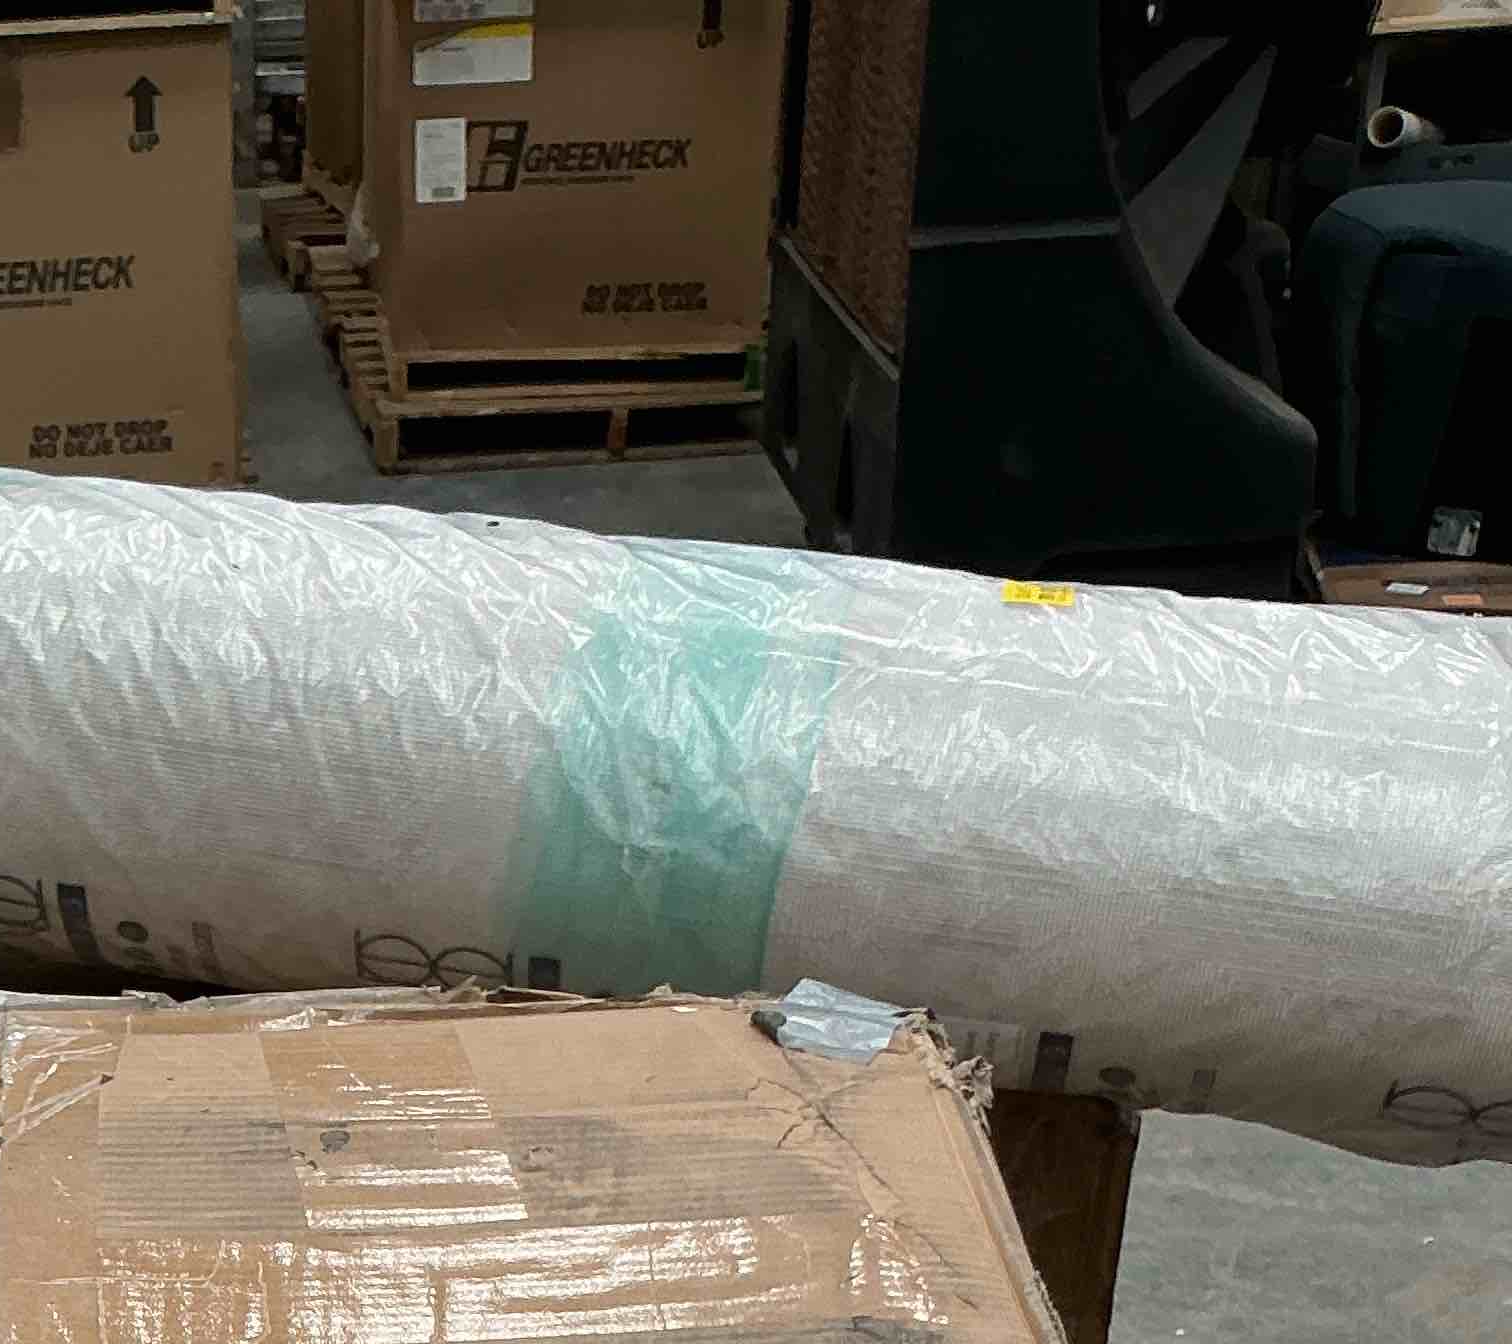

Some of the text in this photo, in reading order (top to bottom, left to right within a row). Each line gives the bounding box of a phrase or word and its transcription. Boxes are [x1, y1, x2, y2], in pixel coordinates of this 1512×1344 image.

[128, 133, 161, 153] UP
[522, 139, 693, 173] GREENHECK
[32, 419, 169, 441] DO NOT DROP
[29, 436, 175, 459] NO DEJE CAER
